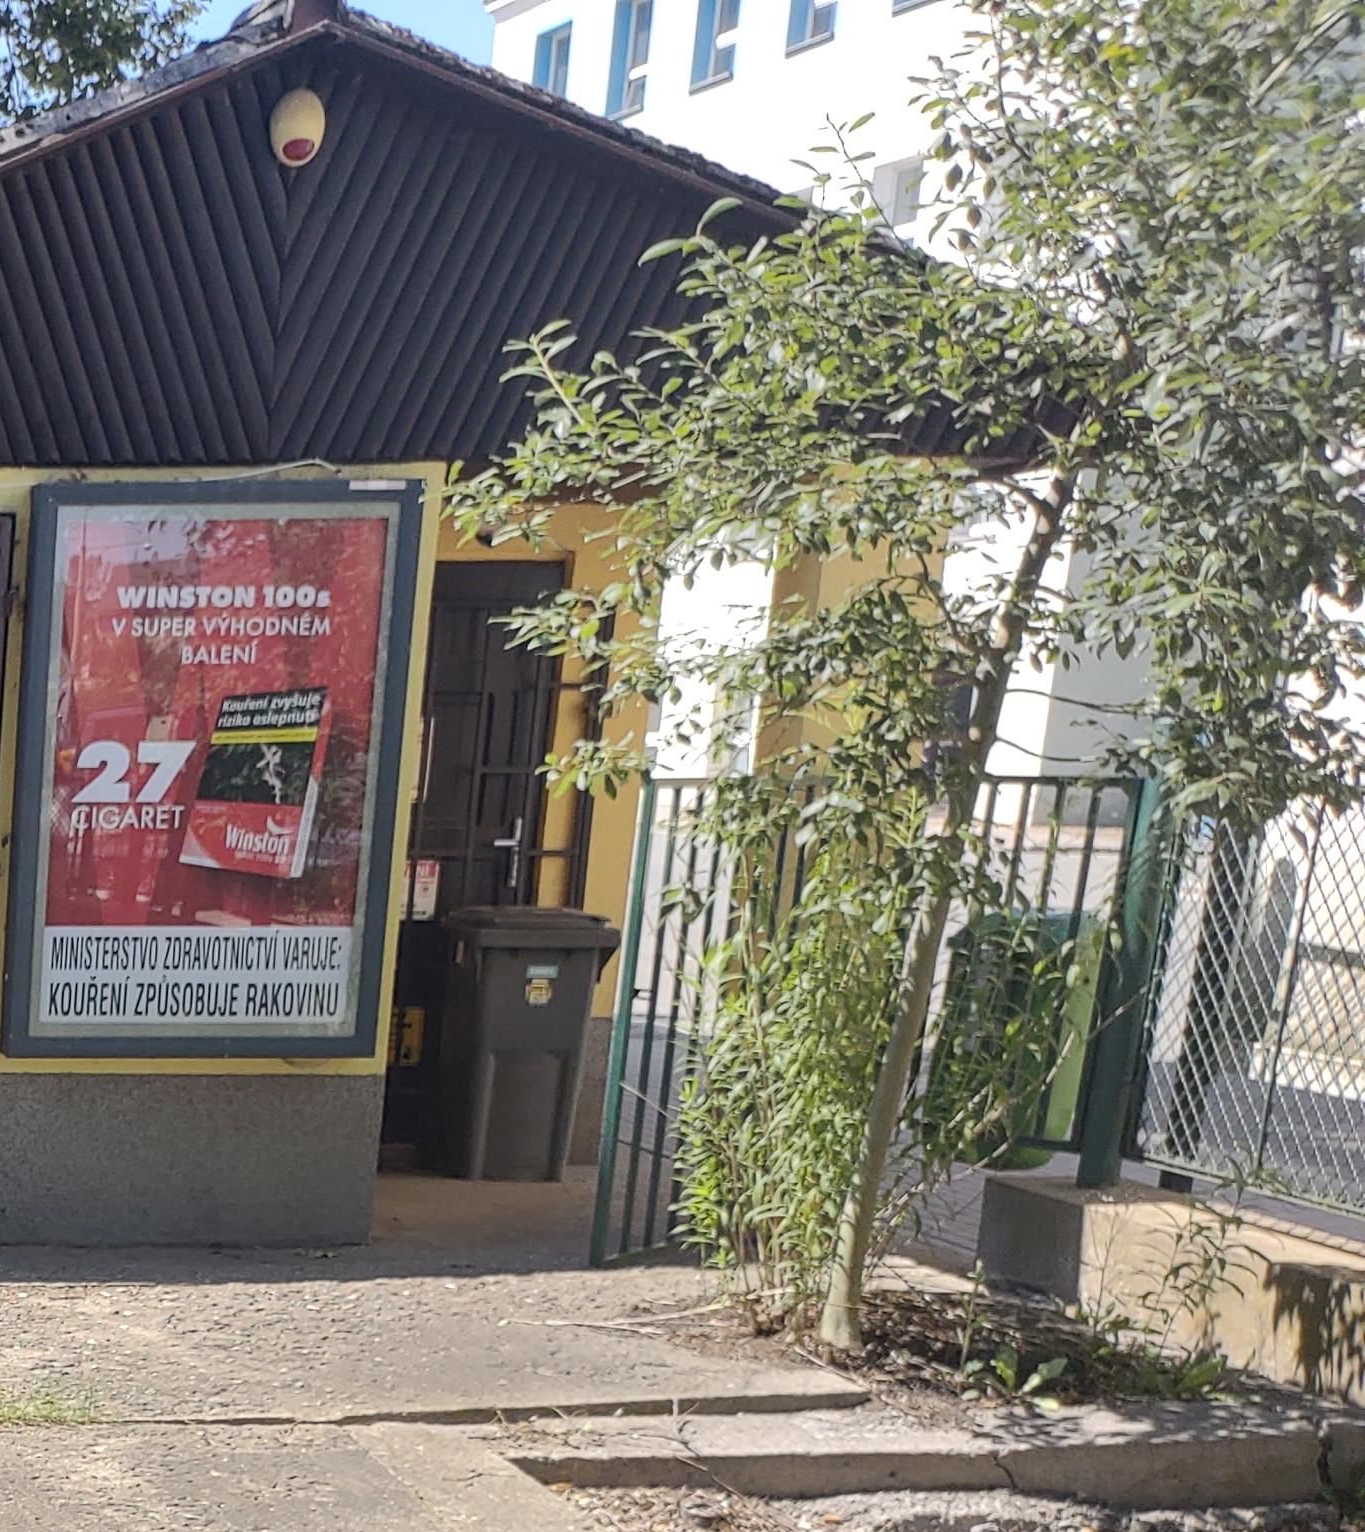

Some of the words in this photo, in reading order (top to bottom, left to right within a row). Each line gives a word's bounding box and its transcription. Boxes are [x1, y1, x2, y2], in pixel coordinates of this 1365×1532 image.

[117, 585, 255, 609] WINSTON
[262, 585, 331, 609] 100s
[112, 617, 126, 637] V
[131, 616, 196, 638] SUPER
[203, 611, 331, 636] VÝHODNÉM
[181, 640, 258, 665] BALENÍ
[222, 696, 269, 712] Kouření
[270, 692, 321, 711] zvyšuje
[217, 713, 250, 728] riziko
[71, 740, 197, 803] 27
[71, 804, 185, 830] CIGARET
[225, 823, 290, 854] Winston
[51, 936, 158, 971] MINISTERSTVO
[163, 931, 280, 971] ZDRAVOTNICTVÍ
[48, 976, 130, 1017] KOUŘENÍ
[135, 975, 239, 1017] ZPŮSOBUJE
[245, 982, 340, 1017] RAKOVINU
